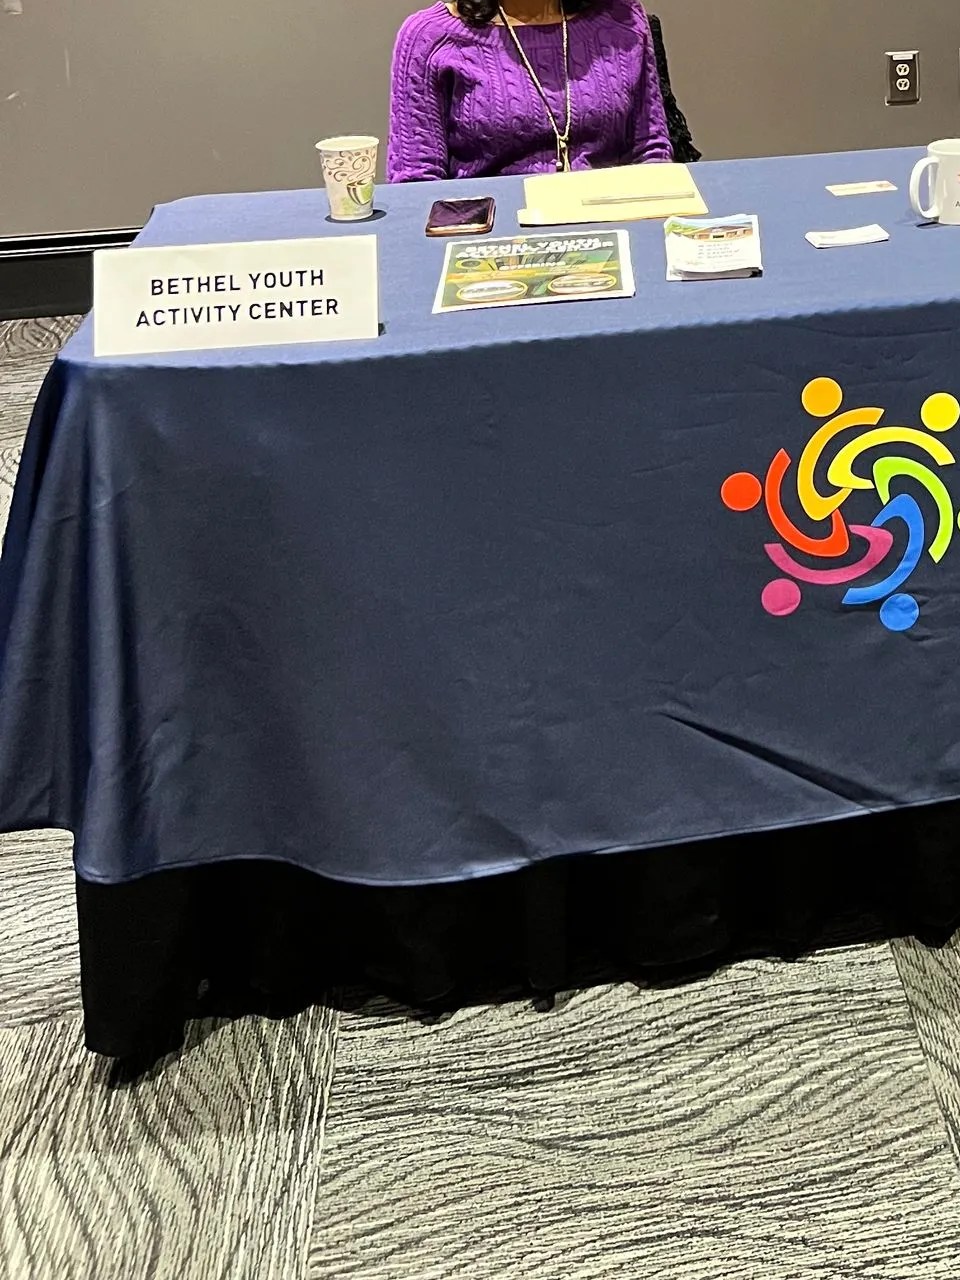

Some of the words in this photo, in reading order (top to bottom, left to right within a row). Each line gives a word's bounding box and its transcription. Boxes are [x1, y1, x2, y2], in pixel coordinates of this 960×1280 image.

[151, 274, 241, 296] BETHEL
[248, 269, 325, 290] YOUTH
[135, 304, 242, 328] ACTIVITY
[248, 298, 339, 320] CENTER
